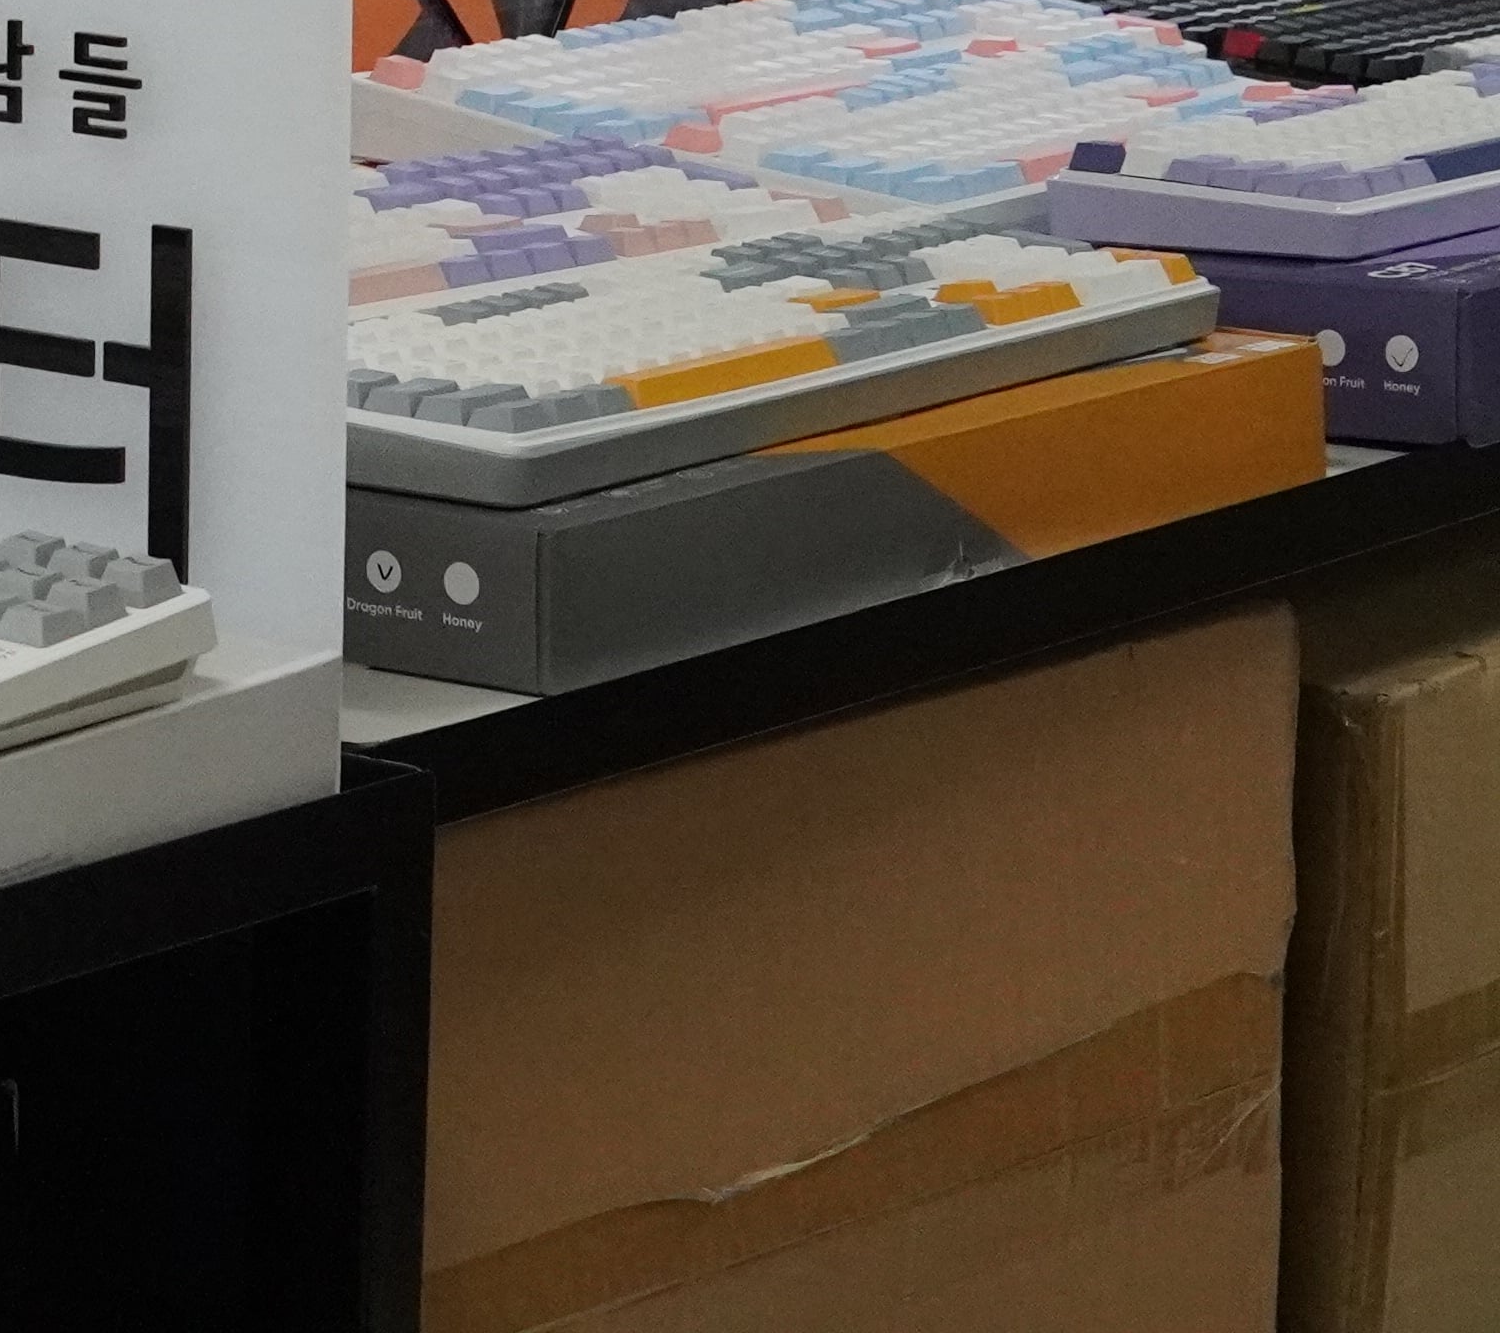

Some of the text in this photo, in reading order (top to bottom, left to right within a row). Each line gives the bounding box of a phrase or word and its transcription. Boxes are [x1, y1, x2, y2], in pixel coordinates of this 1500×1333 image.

[1384, 379, 1421, 396] Honey
[346, 596, 423, 622] Dragon Fruit
[442, 611, 483, 633] Honey
